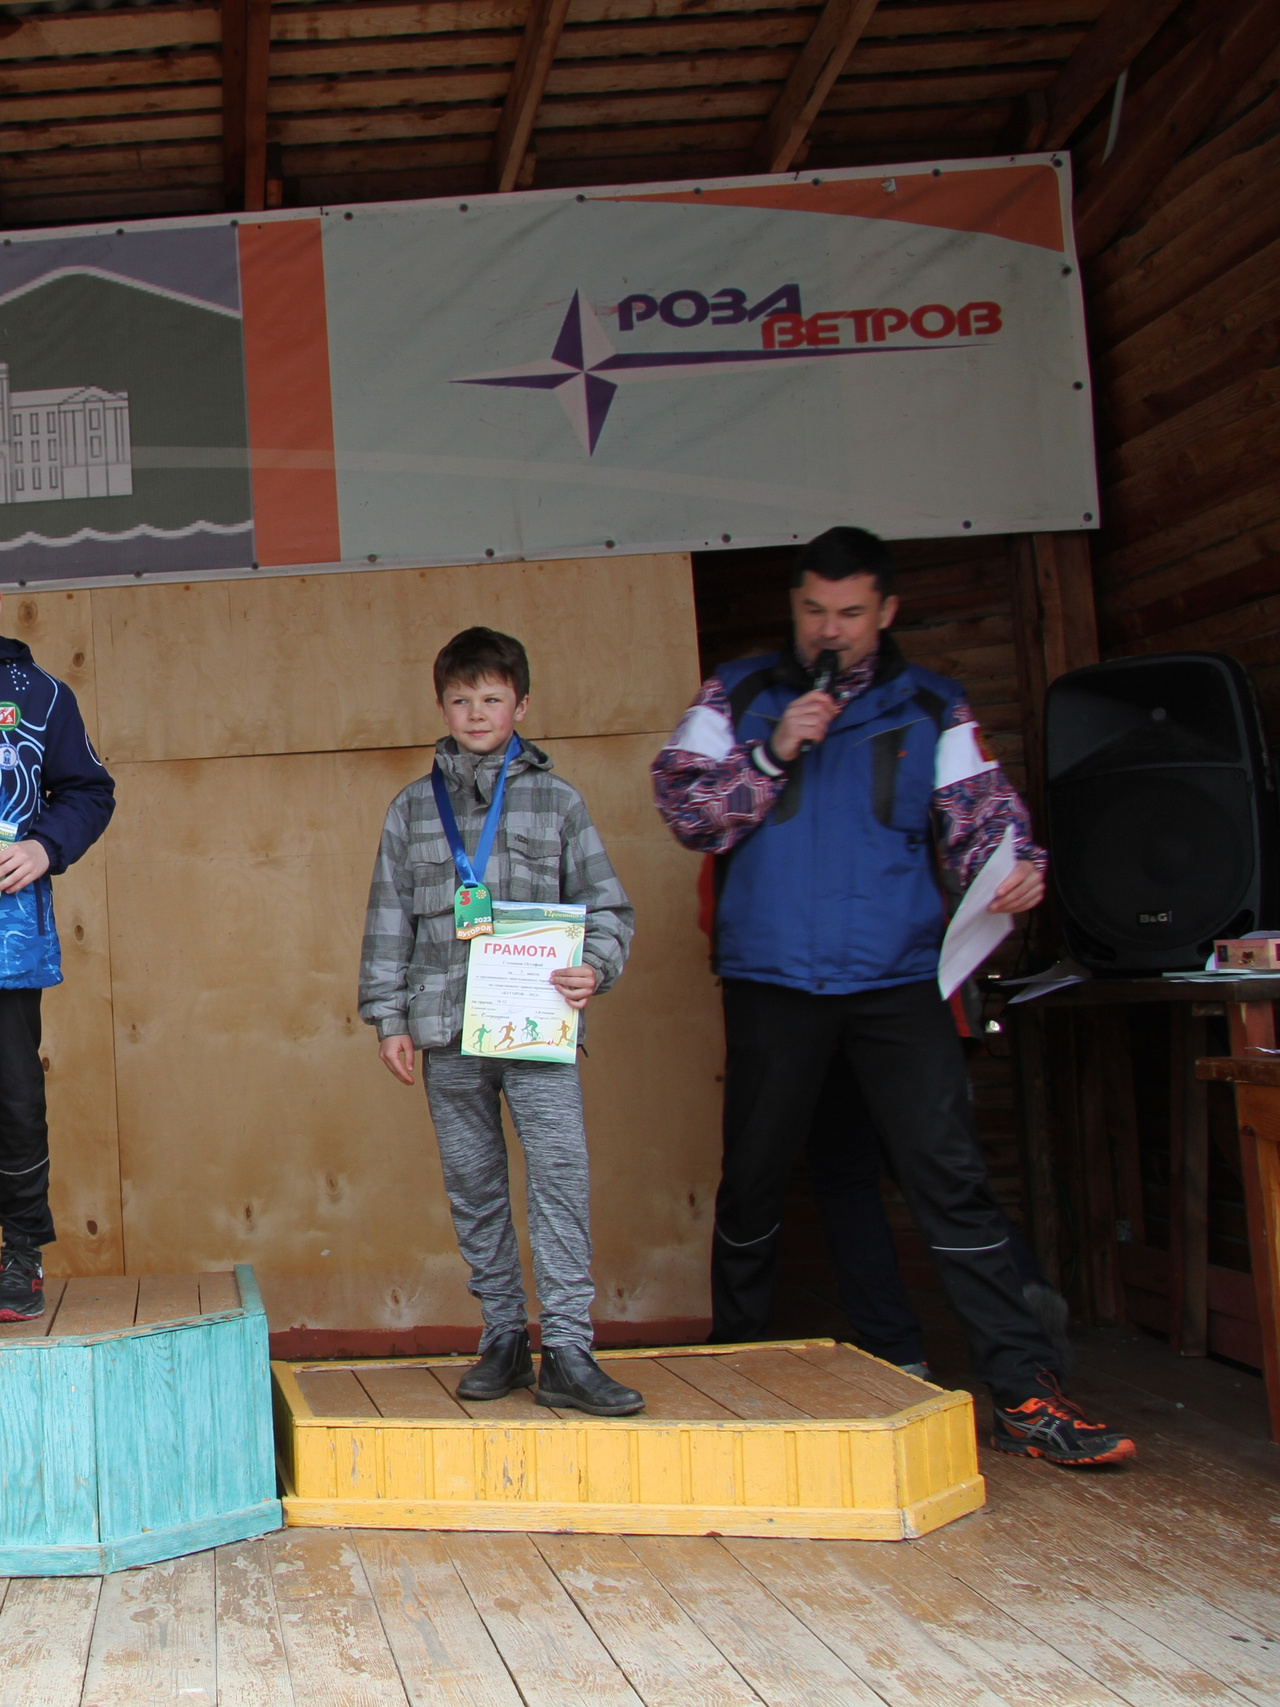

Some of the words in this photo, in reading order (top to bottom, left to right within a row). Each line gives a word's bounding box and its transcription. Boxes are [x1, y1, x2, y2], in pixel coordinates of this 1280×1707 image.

[618, 284, 802, 332] РОЗА
[761, 301, 1003, 350] ВЕТРОВ
[460, 890, 472, 905] 3
[474, 916, 492, 924] 2023
[457, 925, 493, 937] БУГОРОК
[483, 942, 558, 958] ГРАМОТА
